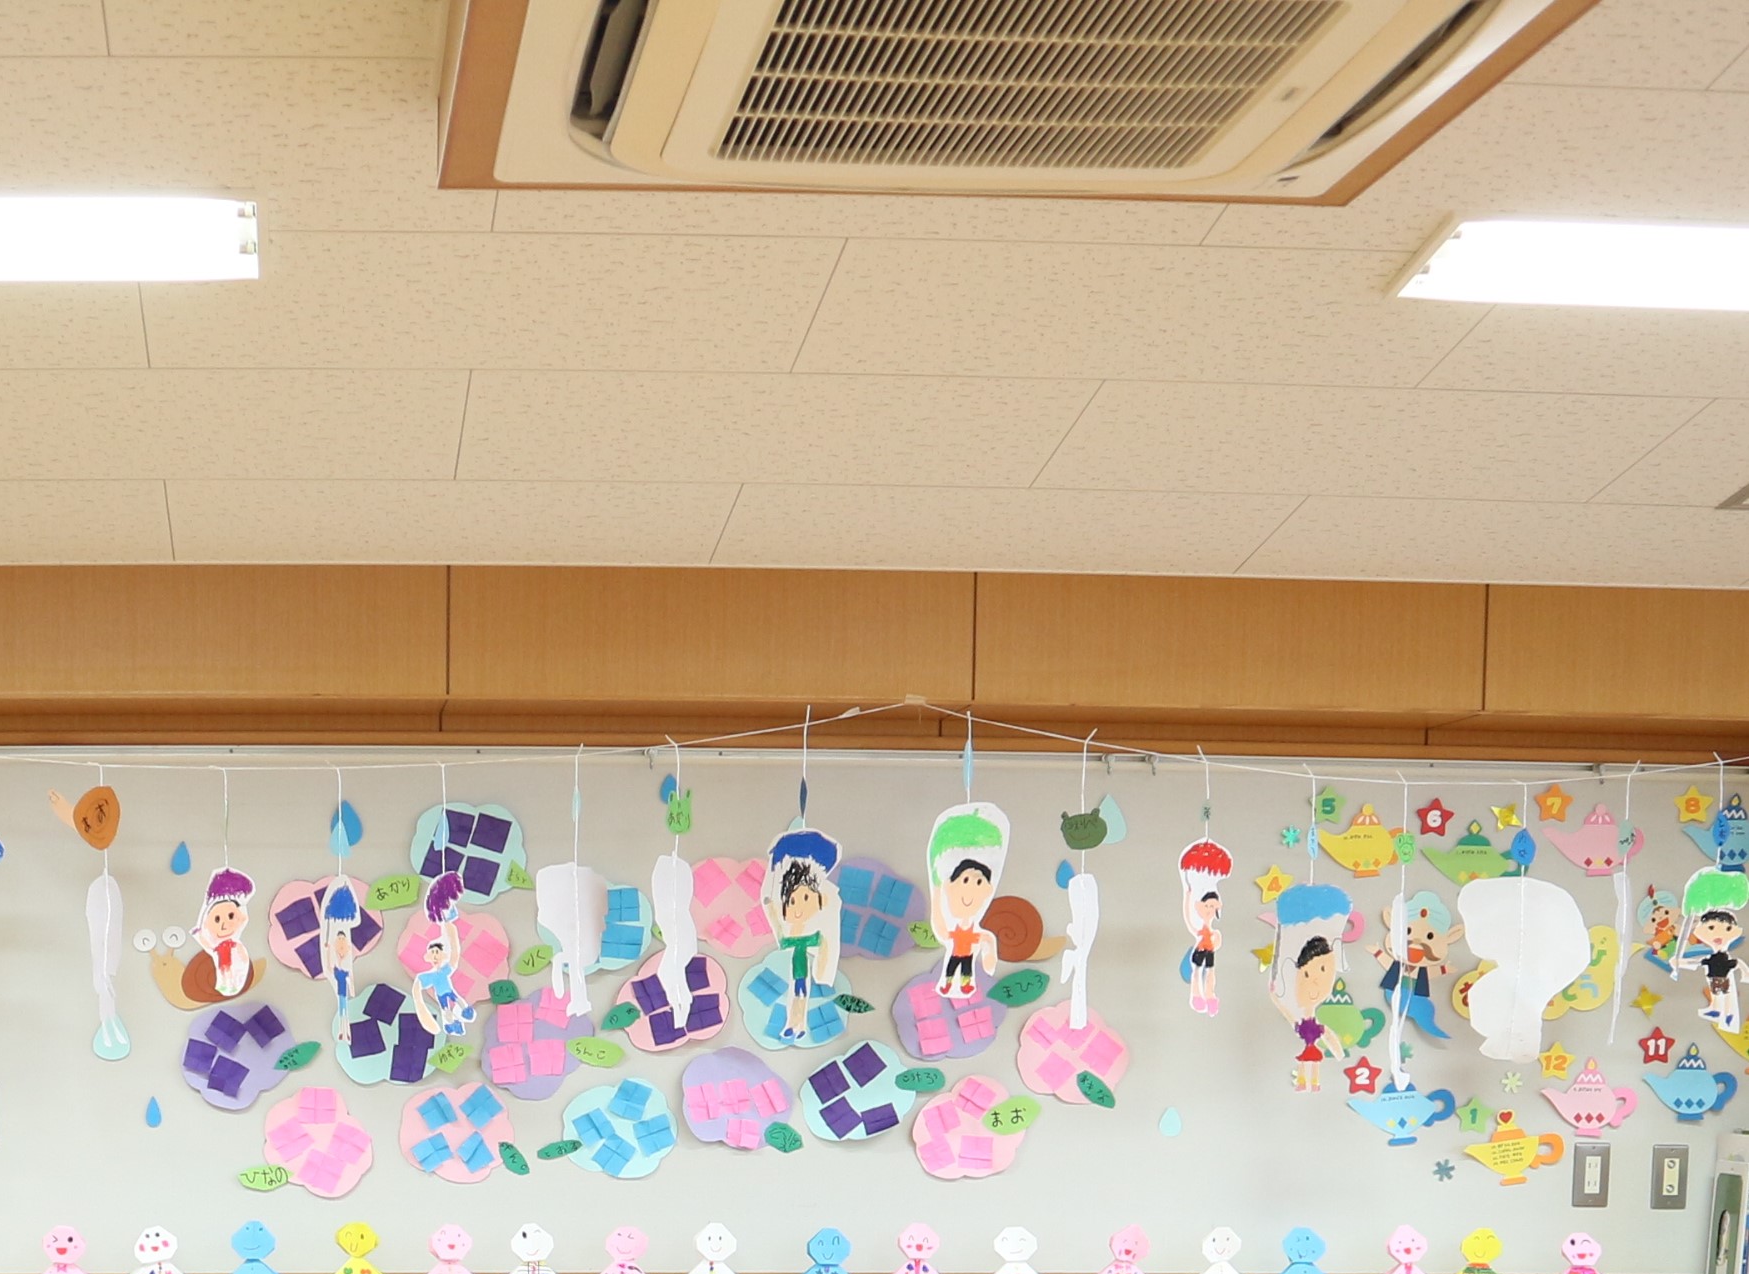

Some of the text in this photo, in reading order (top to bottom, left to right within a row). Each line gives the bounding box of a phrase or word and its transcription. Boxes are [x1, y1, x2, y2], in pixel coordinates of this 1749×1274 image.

[1321, 798, 1336, 814] 5
[1546, 797, 1562, 814] 7
[1685, 797, 1701, 814] 8
[1426, 811, 1442, 827] 6
[376, 878, 410, 900] あかり
[1267, 876, 1282, 892] 4
[523, 949, 545, 967] りく
[1003, 975, 1043, 999] まひろ
[439, 1045, 464, 1063] ゆずる
[575, 1042, 606, 1059] らんこ
[1647, 1038, 1666, 1055] 11
[1544, 1055, 1567, 1071] 12
[1355, 1068, 1370, 1084] 2
[991, 1108, 1027, 1127] まお
[1469, 1109, 1478, 1124] 1
[242, 1166, 288, 1187] ひなの
